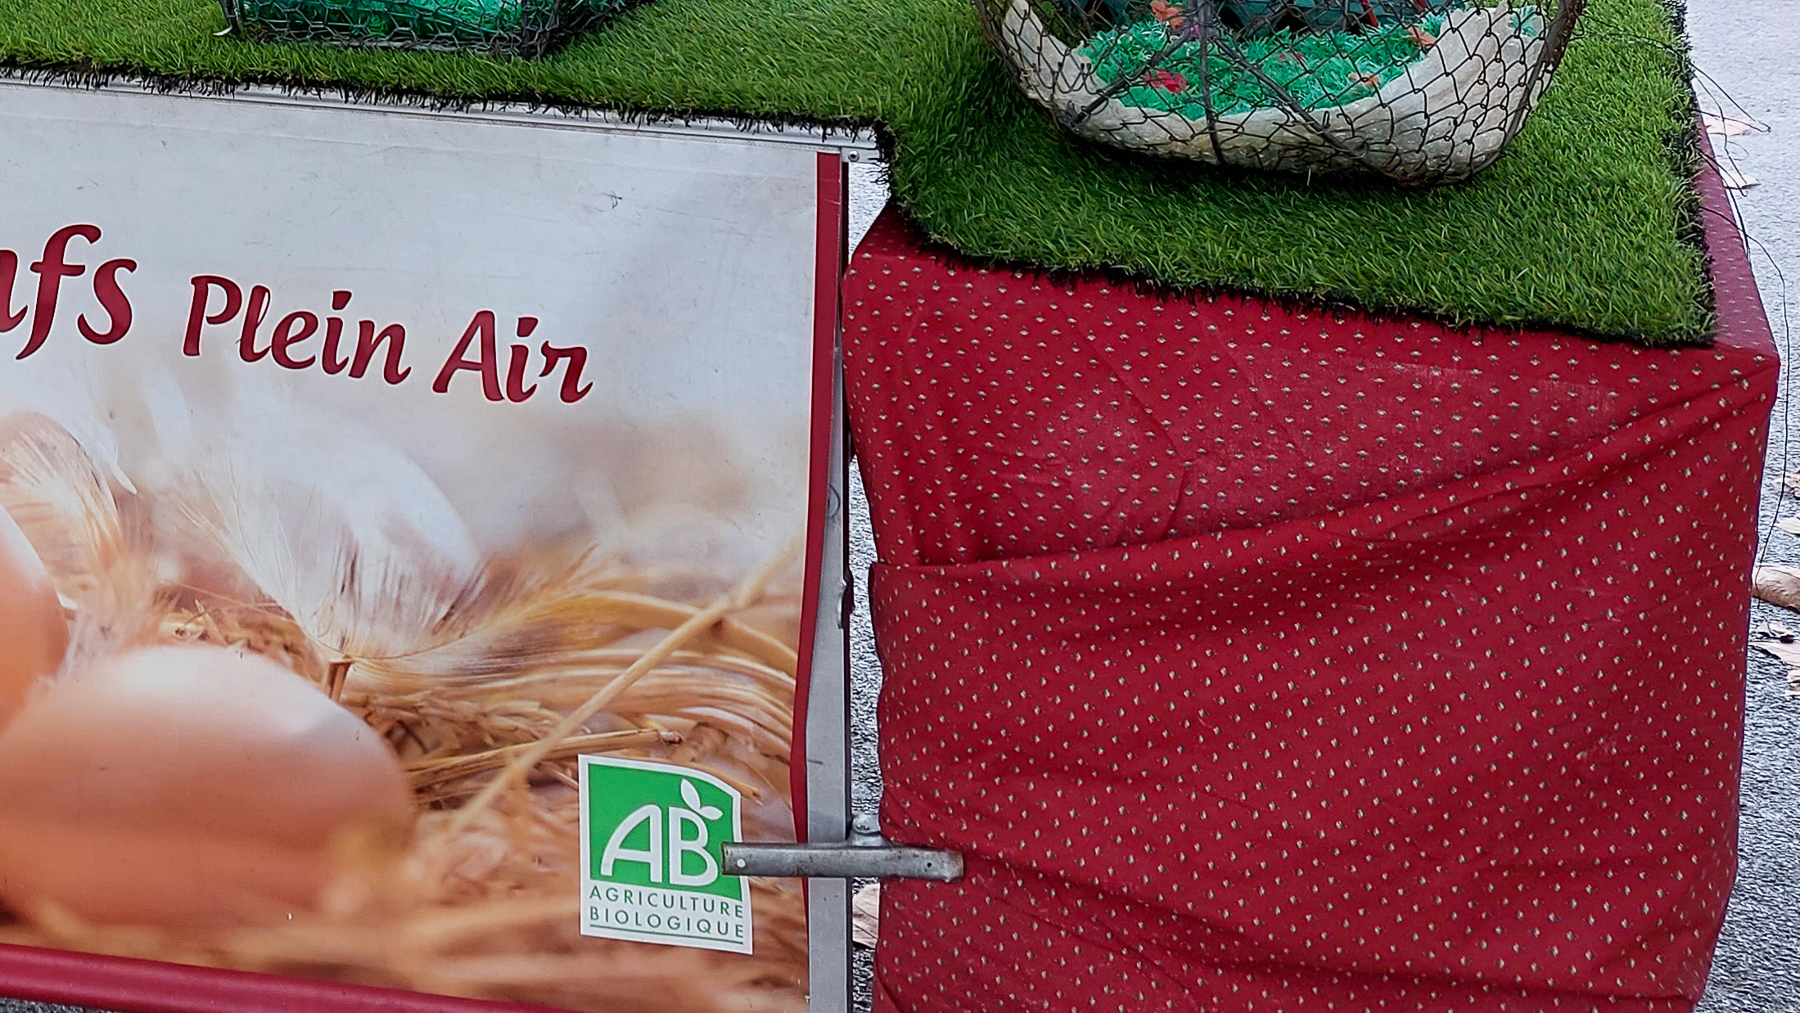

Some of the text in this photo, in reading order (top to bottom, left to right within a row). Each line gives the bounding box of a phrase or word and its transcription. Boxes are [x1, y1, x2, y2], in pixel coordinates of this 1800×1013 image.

[181, 274, 412, 386] Plein
[431, 309, 594, 403] Air
[600, 804, 719, 886] AB
[589, 885, 744, 919] AGRICULTURE
[590, 906, 744, 939] BIOLOGIQUE
